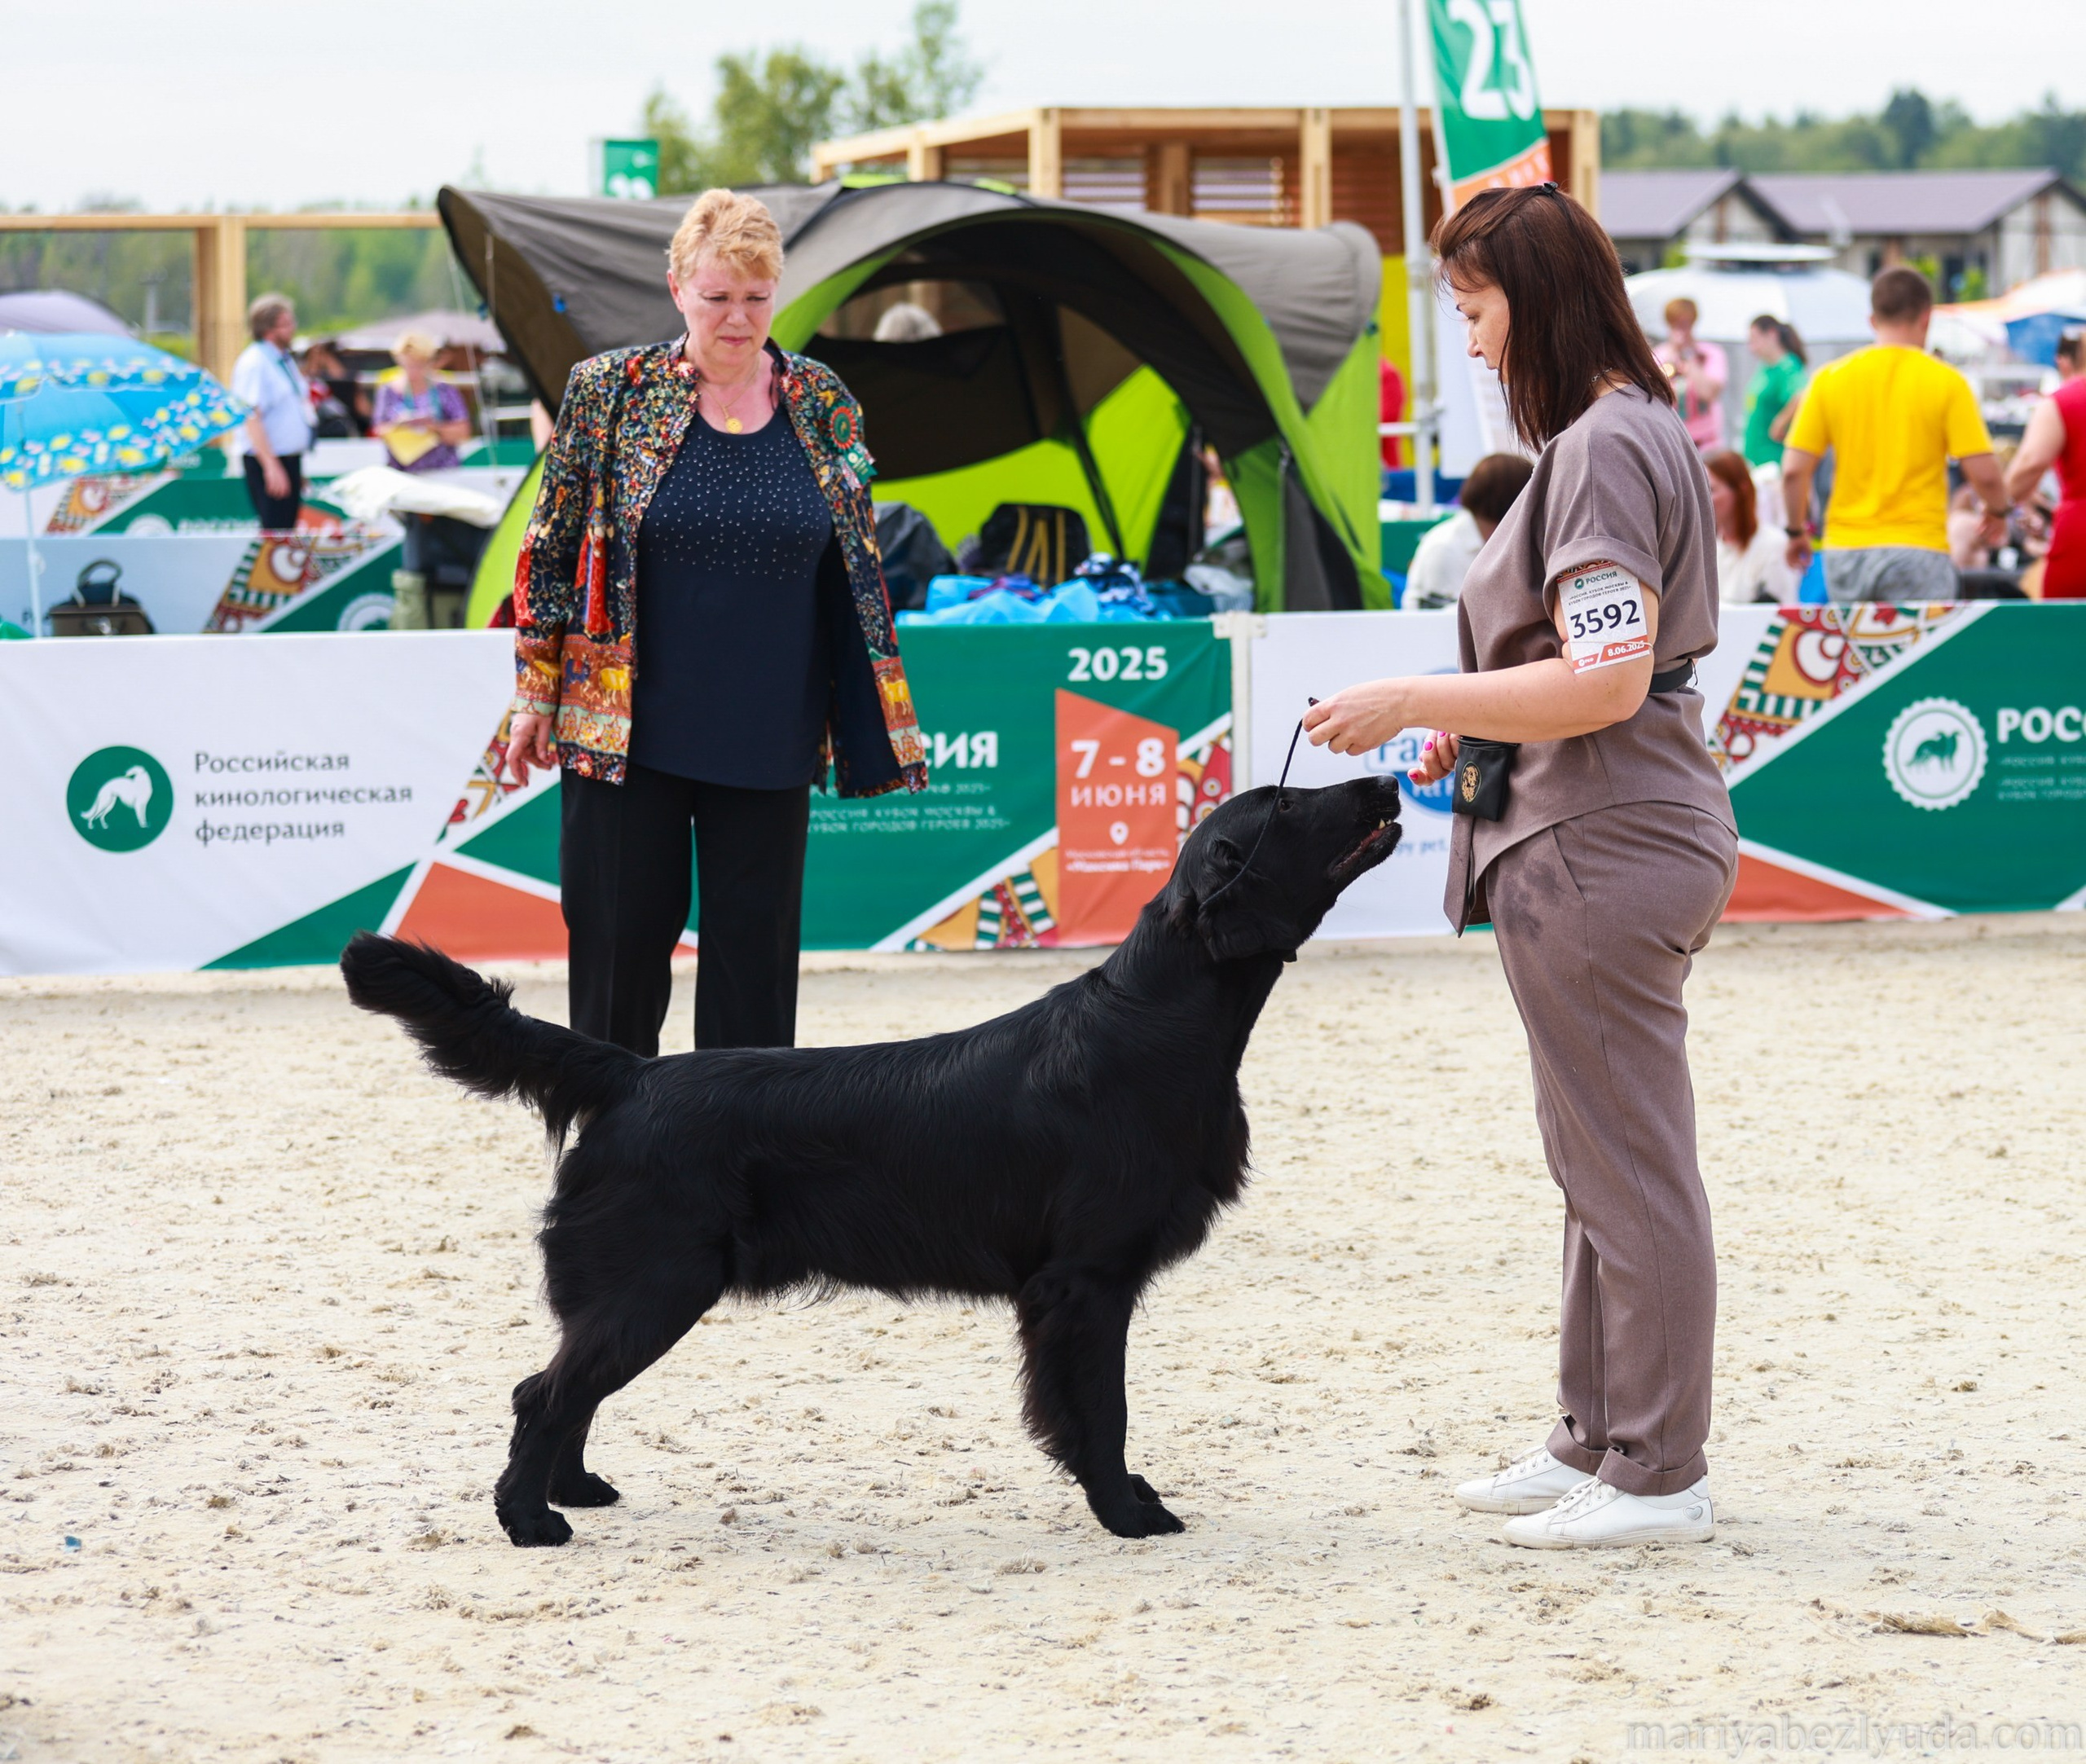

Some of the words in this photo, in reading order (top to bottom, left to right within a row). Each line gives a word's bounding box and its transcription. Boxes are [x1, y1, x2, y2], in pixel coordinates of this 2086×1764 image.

[1586, 571, 1617, 584] РОССИЯ
[1570, 599, 1640, 640] 3592
[1067, 646, 1168, 681] 2025
[1997, 705, 2086, 744] РОС
[194, 749, 350, 774] Российская
[1071, 739, 1101, 779] 7
[1135, 737, 1165, 777] 8
[194, 785, 413, 807] кинологическая
[194, 817, 345, 847] федерация
